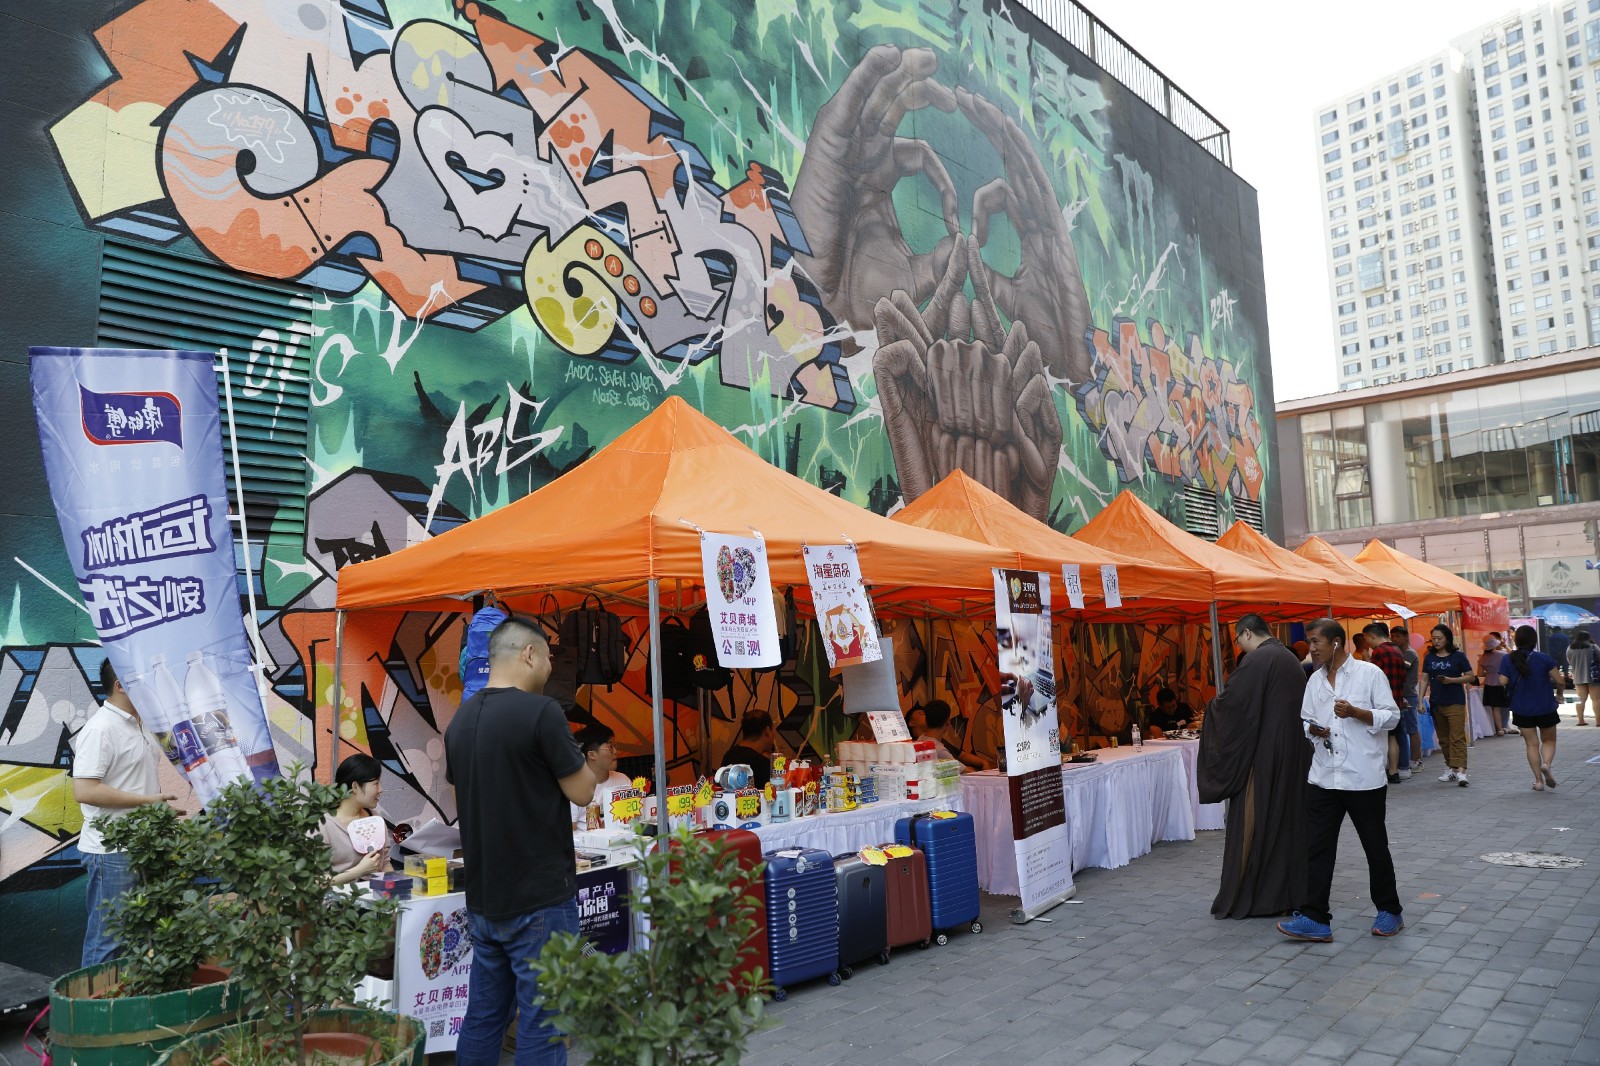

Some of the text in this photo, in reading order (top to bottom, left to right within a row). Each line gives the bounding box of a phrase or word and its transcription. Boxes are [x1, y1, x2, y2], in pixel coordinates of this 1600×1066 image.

[588, 242, 657, 314] MASK
[812, 563, 851, 580] 海量商品
[743, 597, 757, 606] APP
[719, 611, 758, 627] 艾贝商城
[722, 639, 762, 657] 公 测
[451, 964, 472, 977] APP
[413, 984, 469, 1008] 艾贝商城
